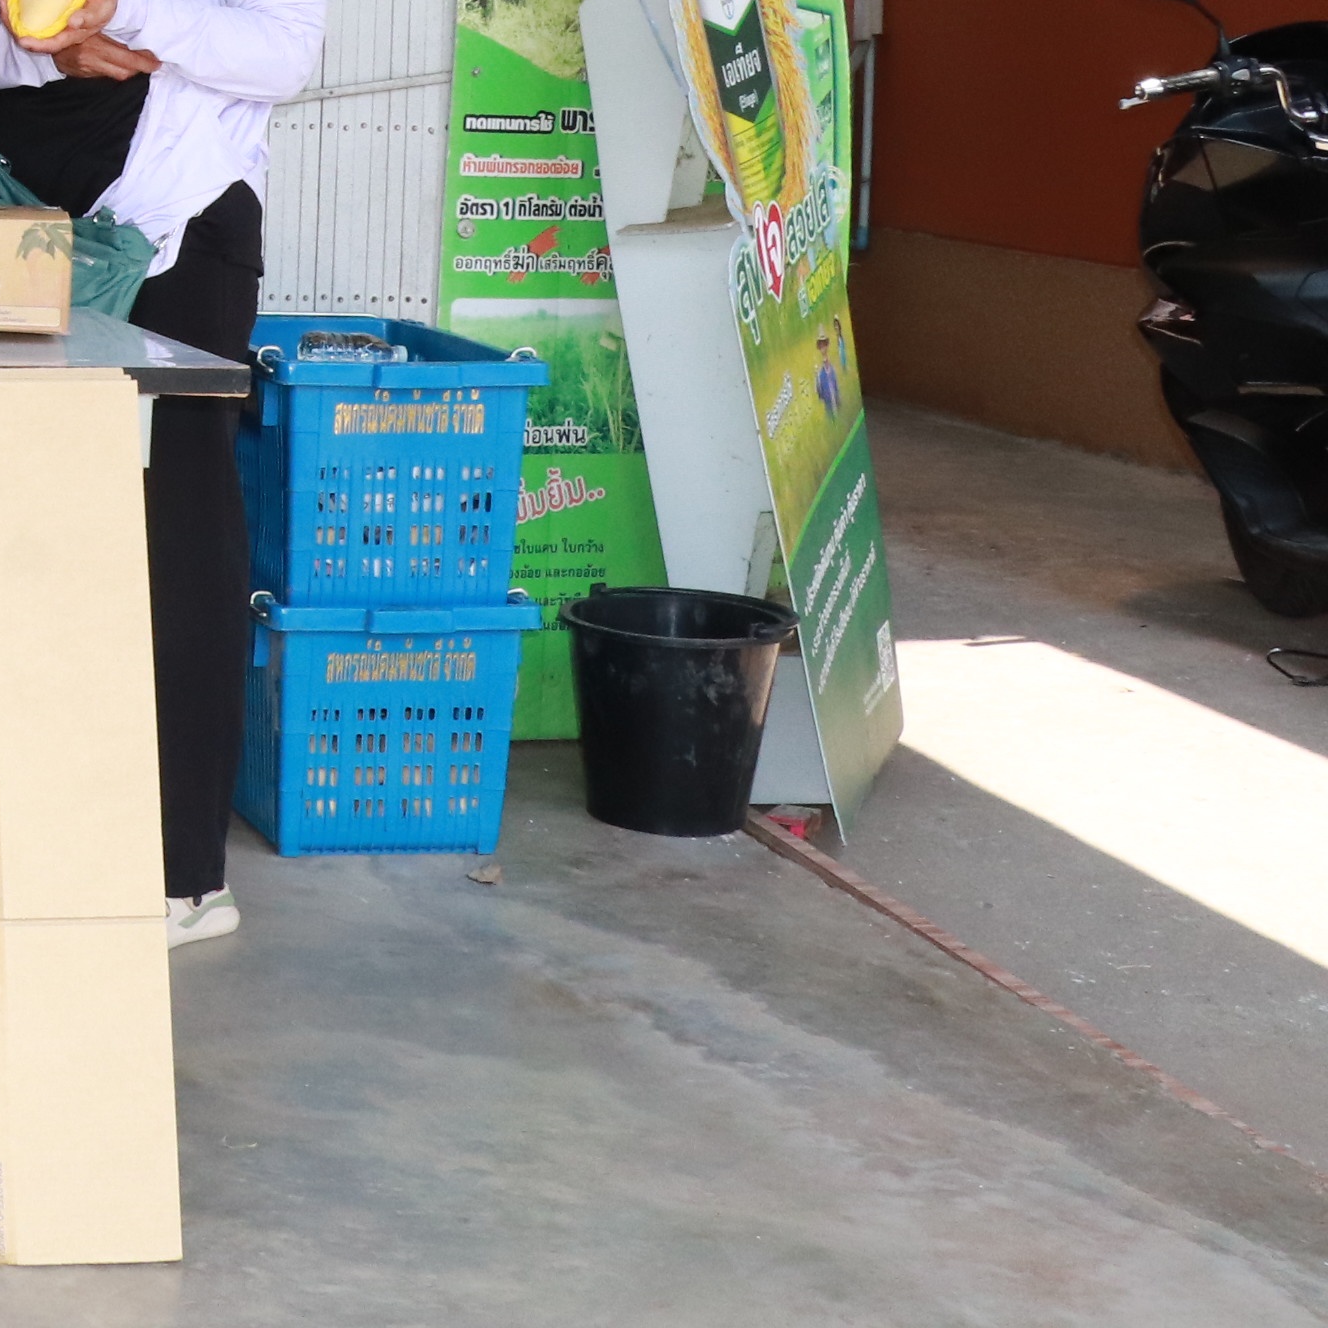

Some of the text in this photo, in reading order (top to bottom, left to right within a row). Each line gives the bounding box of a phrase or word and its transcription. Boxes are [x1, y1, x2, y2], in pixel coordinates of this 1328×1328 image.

[465, 112, 554, 132] ทดแทนการใช้
[459, 195, 604, 218] อัตรา 1 กิโลกรัม ต่อน้ำ
[562, 538, 604, 554] ใบกว้าง
